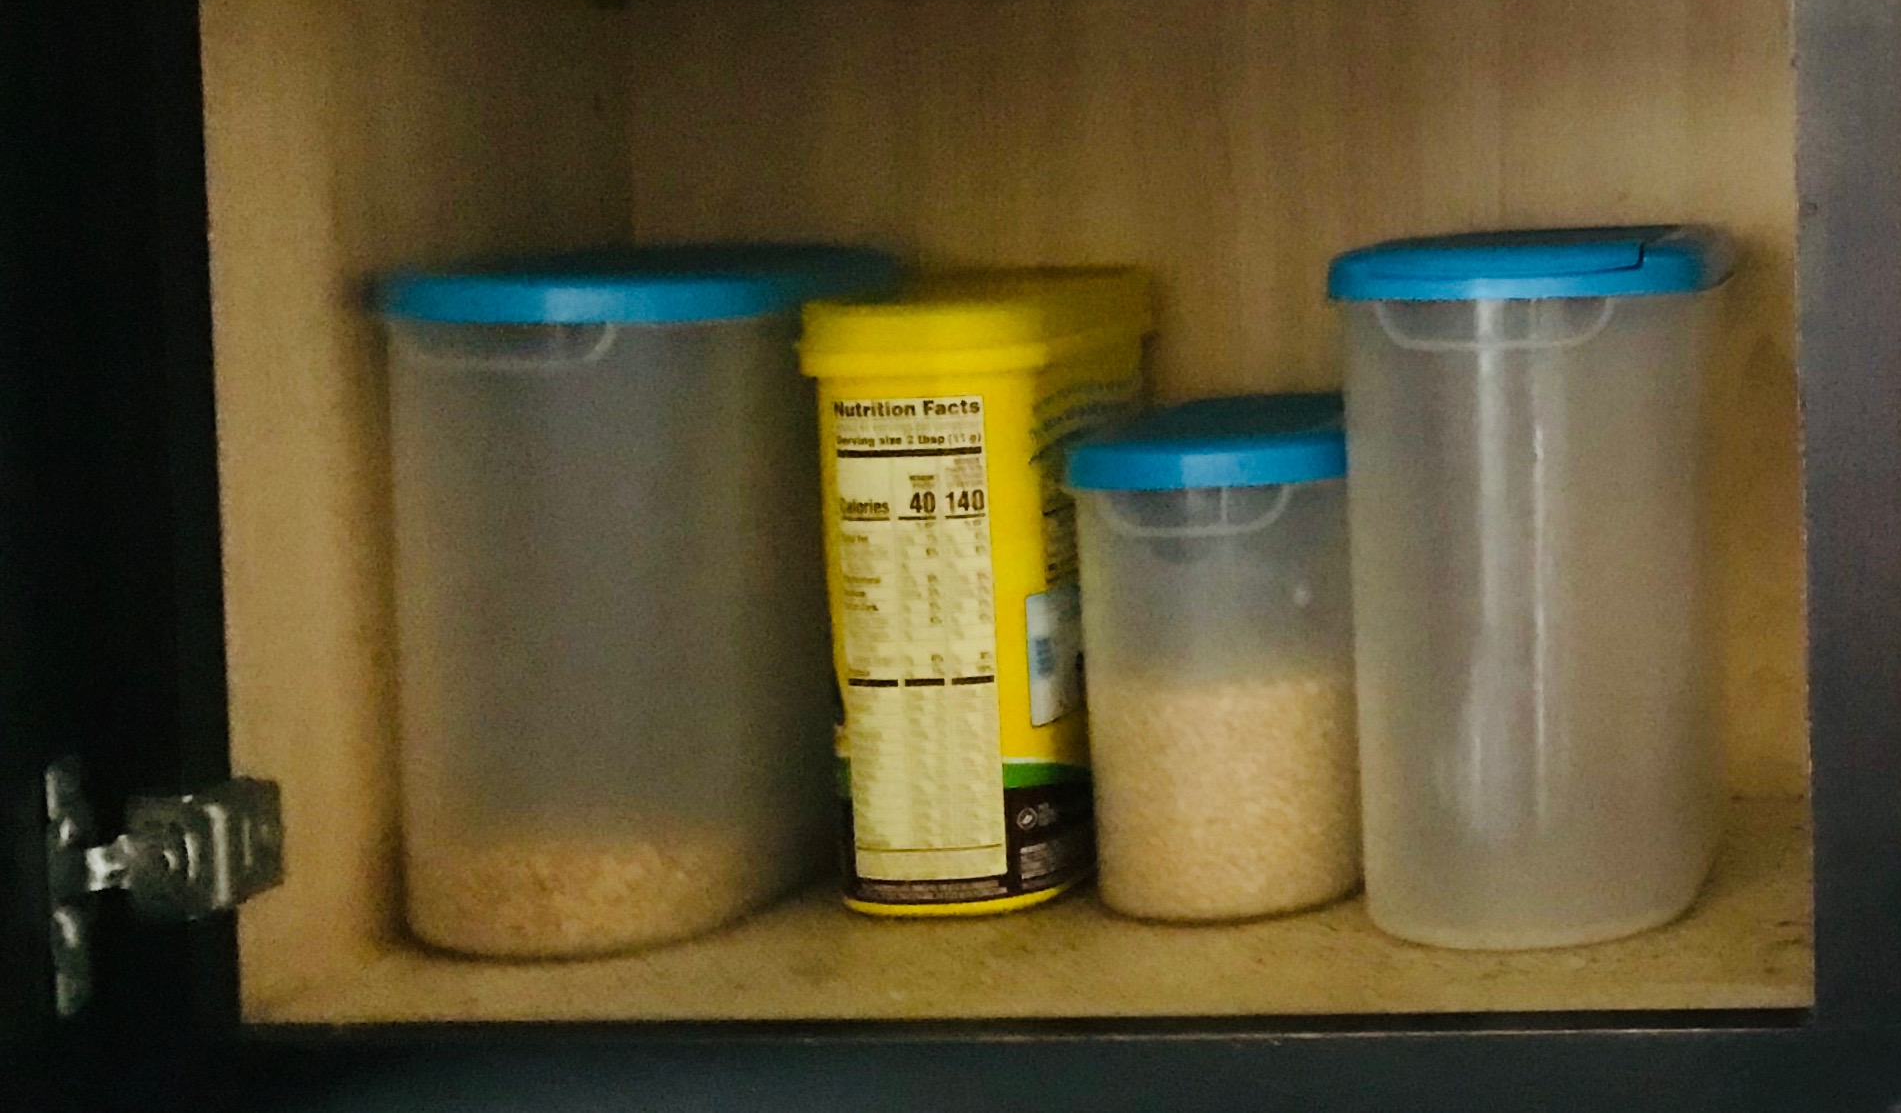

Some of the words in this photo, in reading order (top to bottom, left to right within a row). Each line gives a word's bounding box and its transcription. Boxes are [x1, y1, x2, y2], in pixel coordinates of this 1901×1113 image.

[834, 401, 915, 417] Nutrition
[922, 399, 980, 415] Facts
[878, 436, 903, 445] size
[839, 497, 890, 515] Calories
[909, 491, 936, 514] 40
[945, 489, 985, 514] 140
